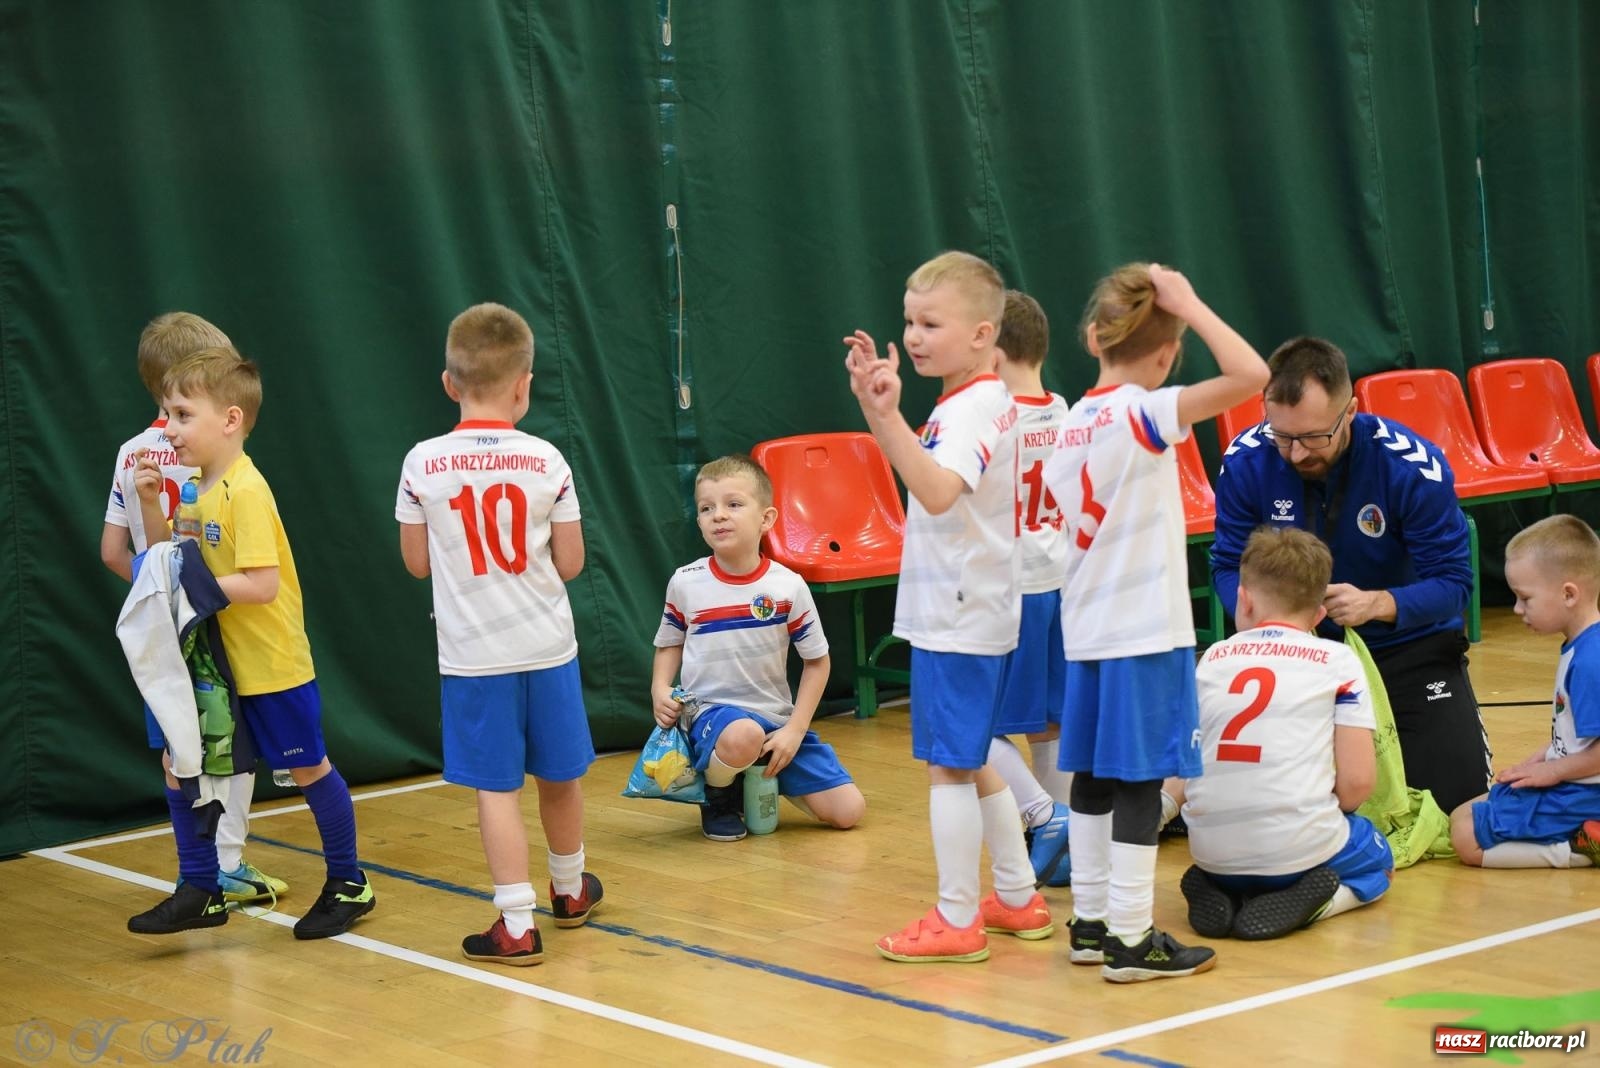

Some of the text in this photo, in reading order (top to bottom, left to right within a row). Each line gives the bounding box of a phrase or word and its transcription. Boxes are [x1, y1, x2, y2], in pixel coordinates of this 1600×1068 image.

[476, 437, 499, 446] 1920
[425, 452, 547, 475] LKS KRZYŻANOWICE
[1271, 513, 1295, 521] hummel
[448, 482, 528, 577] 10
[1261, 629, 1284, 638] 1920
[1208, 641, 1330, 665] LKS KRZYŻANOWICE
[1426, 691, 1452, 701] hummel
[1216, 666, 1277, 763] 2
